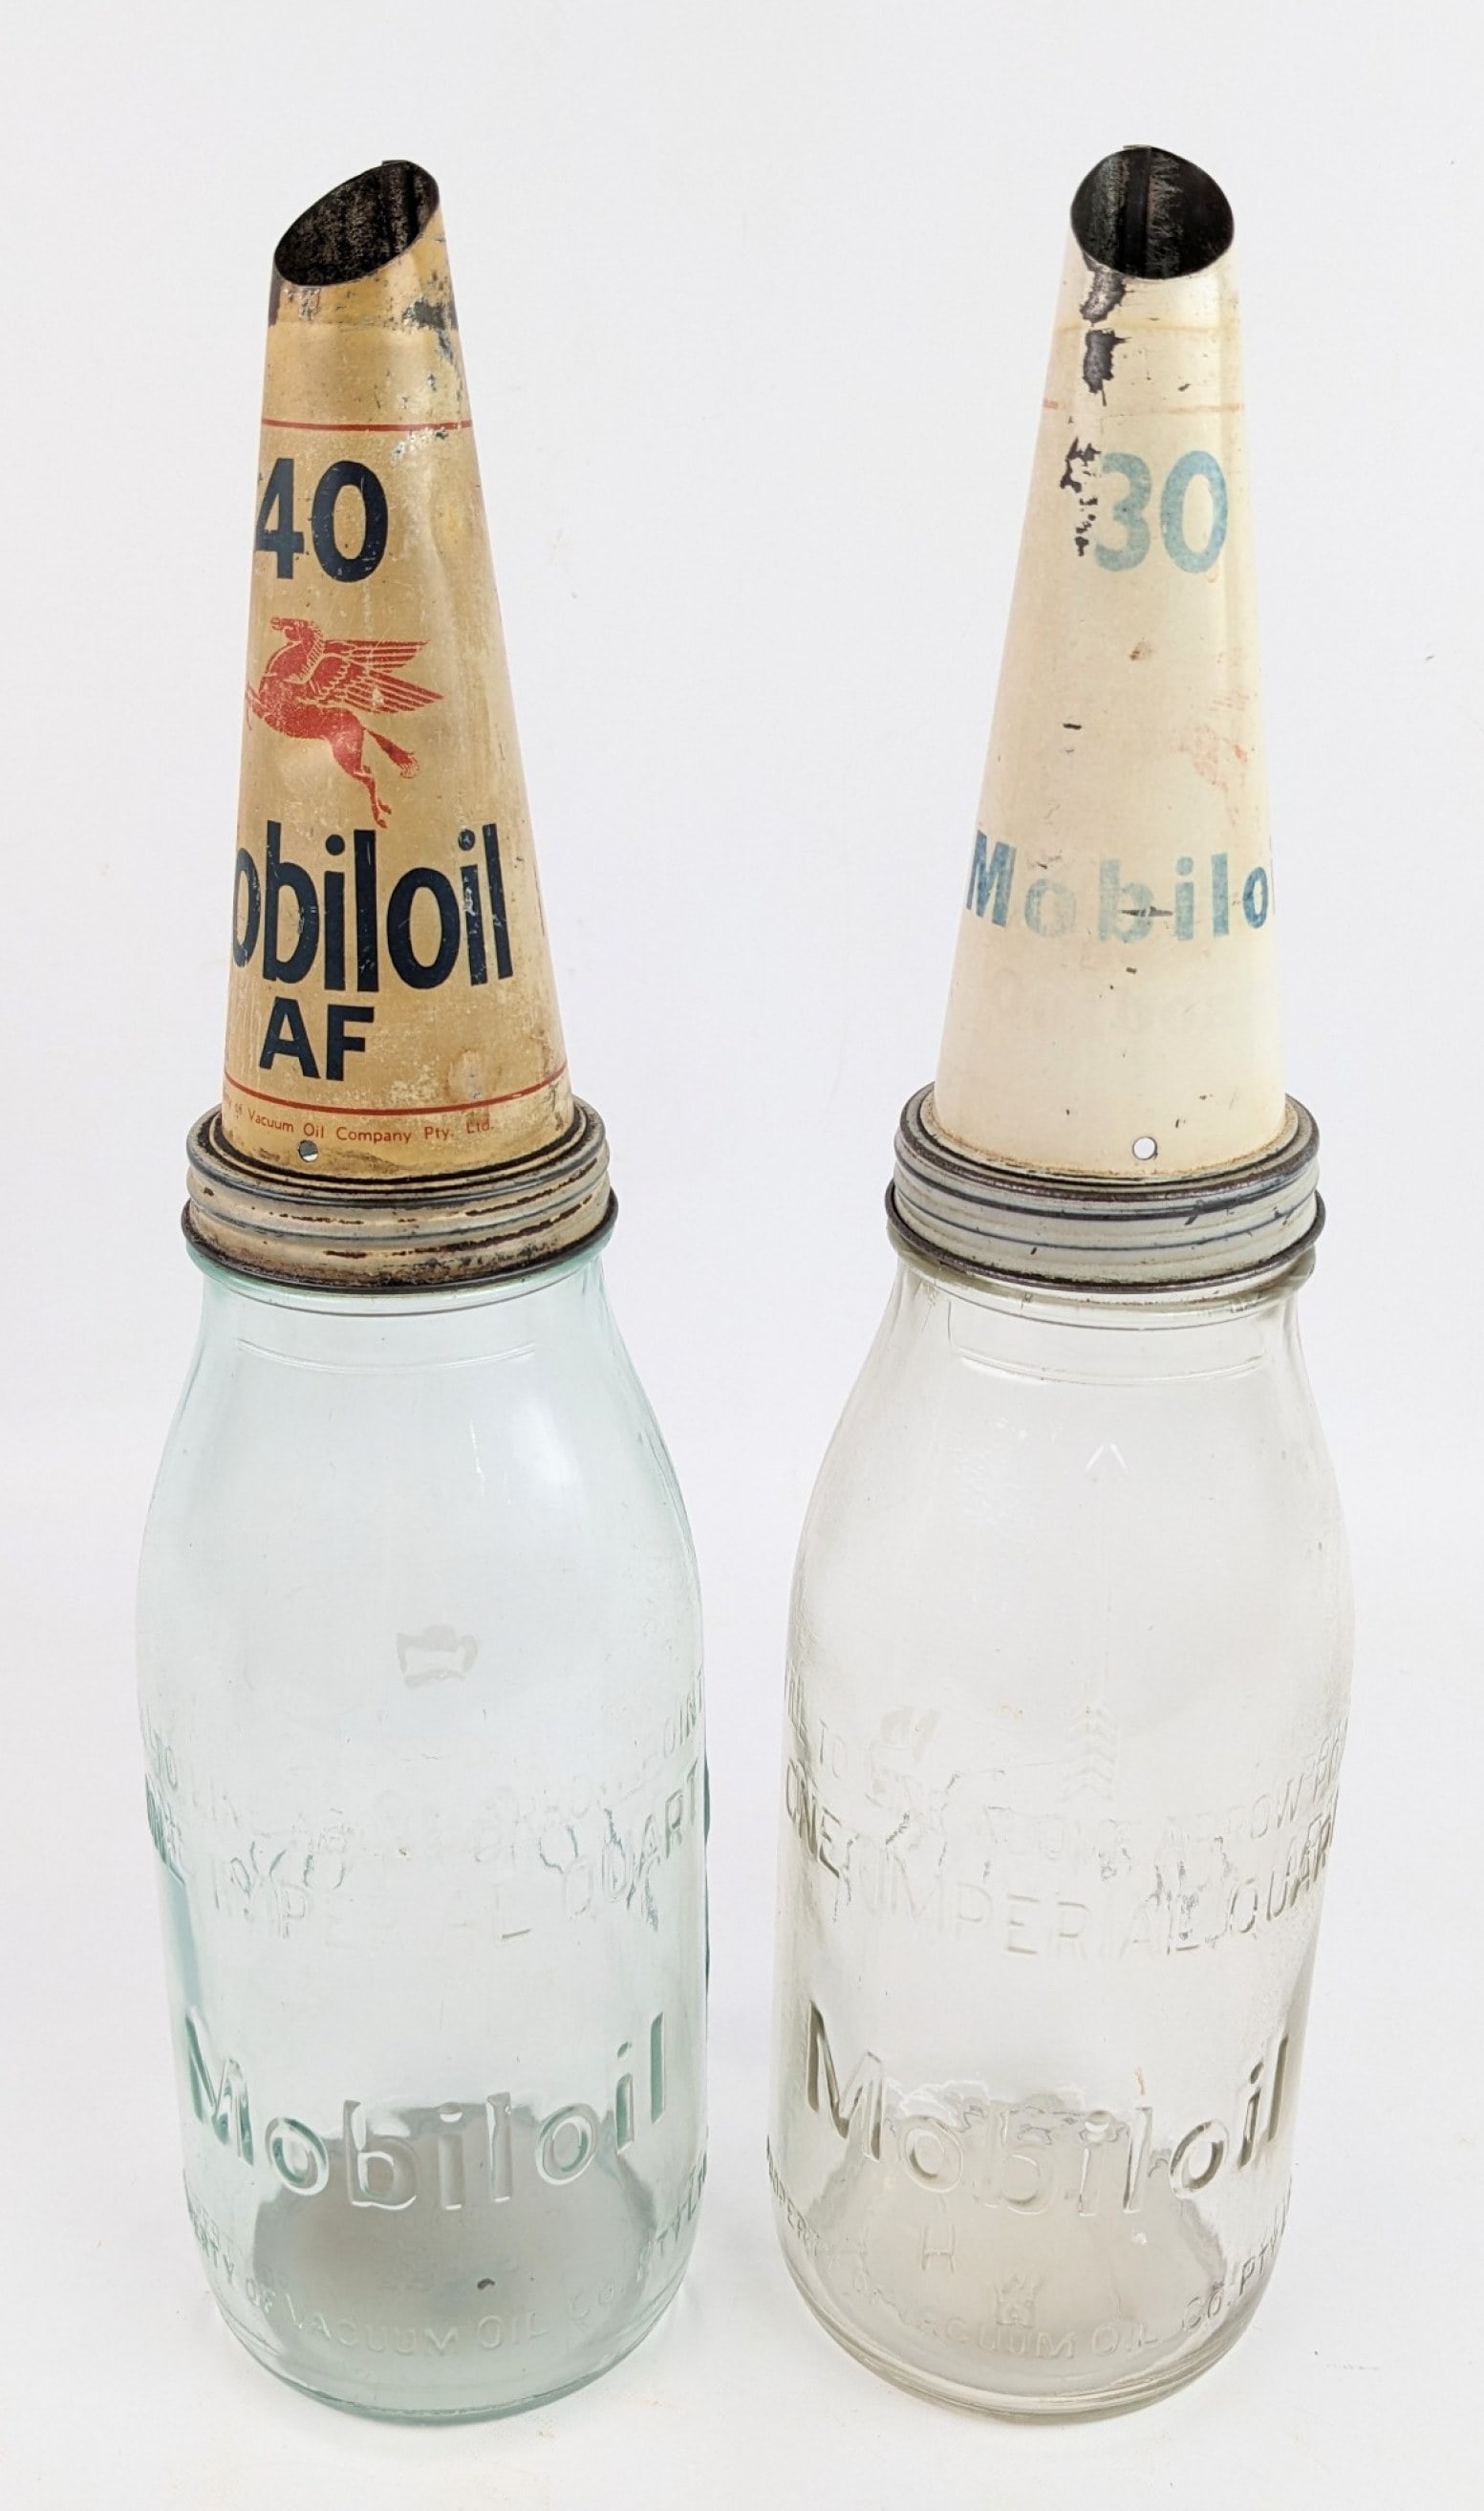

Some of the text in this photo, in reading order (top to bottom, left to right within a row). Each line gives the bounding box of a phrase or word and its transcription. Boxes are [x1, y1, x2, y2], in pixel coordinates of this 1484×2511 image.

[254, 457, 389, 583] 40
[1093, 450, 1228, 574] 30
[259, 996, 375, 1081] AF
[247, 1107, 294, 1133] Vacuum
[303, 1122, 324, 1138] Oil
[335, 1126, 412, 1144] Company
[423, 1126, 455, 1141] Pty.
[184, 2009, 665, 2211] Mobiloil
[807, 1999, 1290, 2218] Mobiloil
